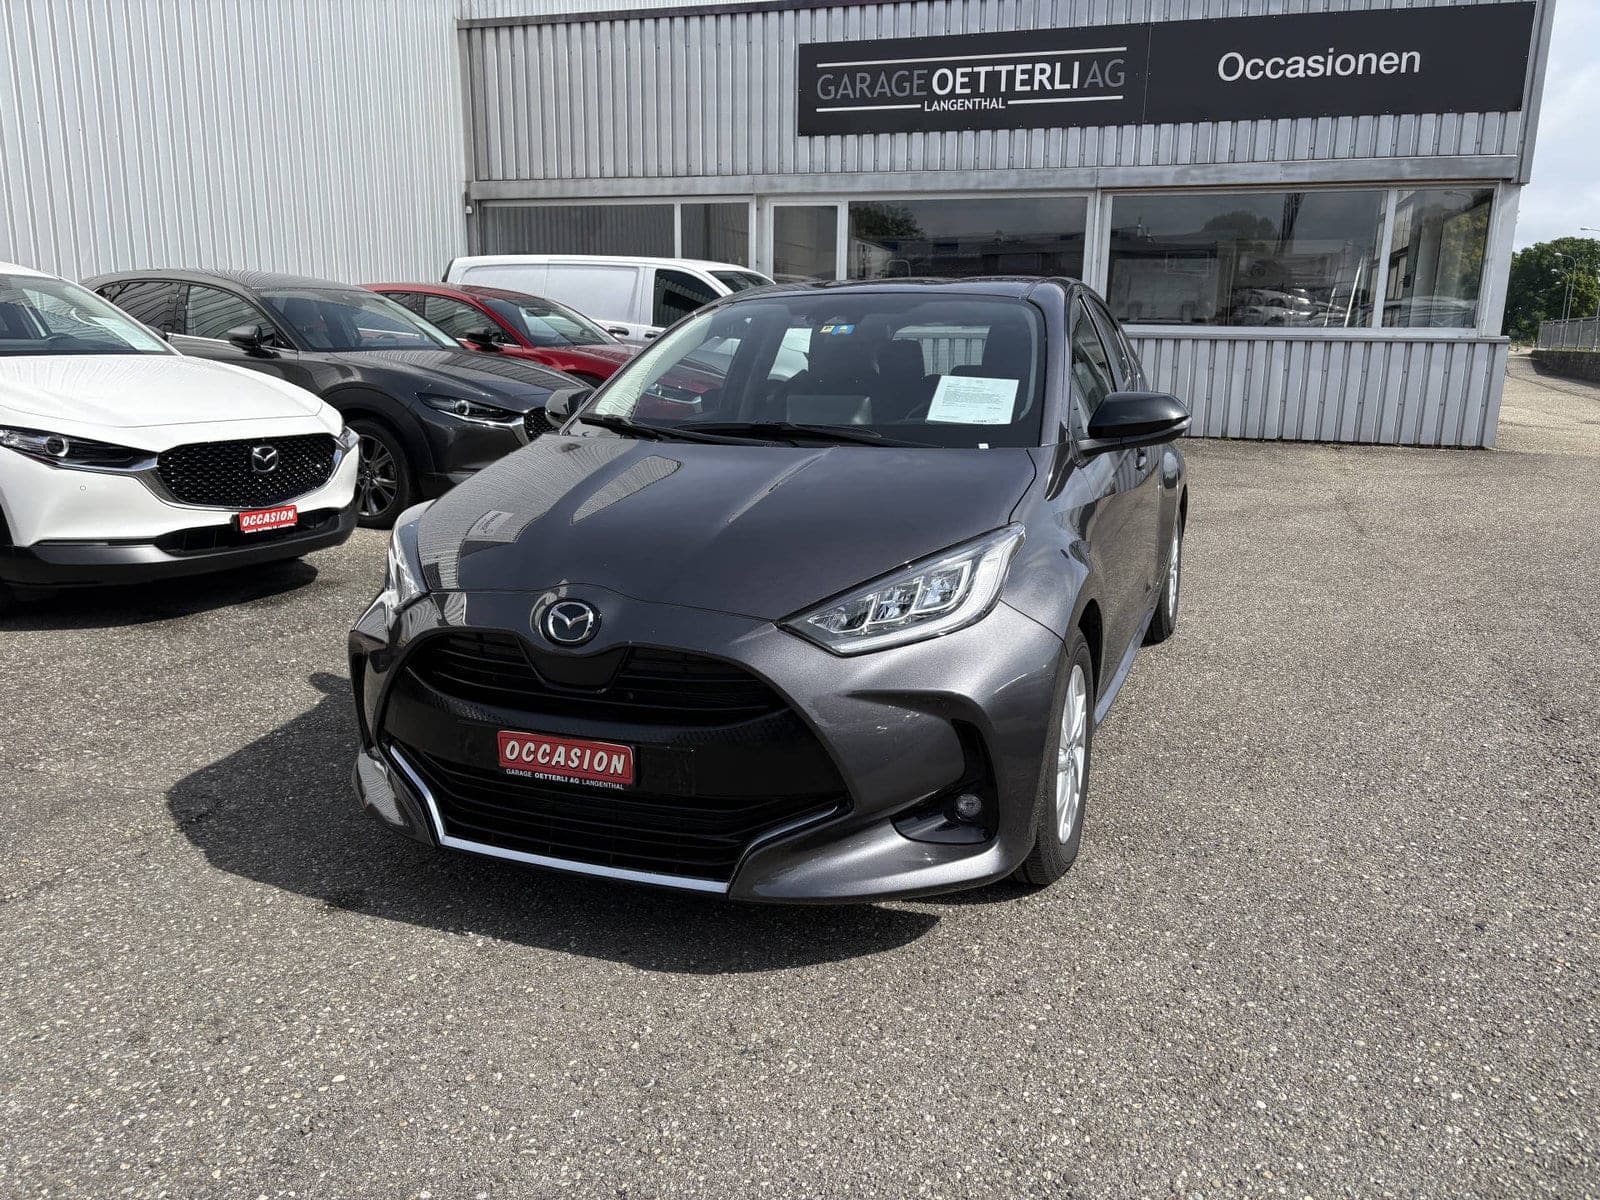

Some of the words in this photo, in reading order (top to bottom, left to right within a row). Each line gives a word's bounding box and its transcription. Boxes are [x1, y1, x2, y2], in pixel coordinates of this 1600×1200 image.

[1217, 47, 1421, 82] Occasionen
[816, 69, 929, 100] GARAGE
[931, 60, 1080, 96] OETTERLI
[1083, 58, 1126, 88] AG
[924, 97, 1006, 112] LANGENTHAL
[243, 509, 294, 526] OCCASION
[505, 740, 625, 774] OCCASION
[506, 768, 532, 777] GARAGE
[534, 772, 568, 782] OETTERLI
[582, 779, 624, 790] LANGENTHAL
